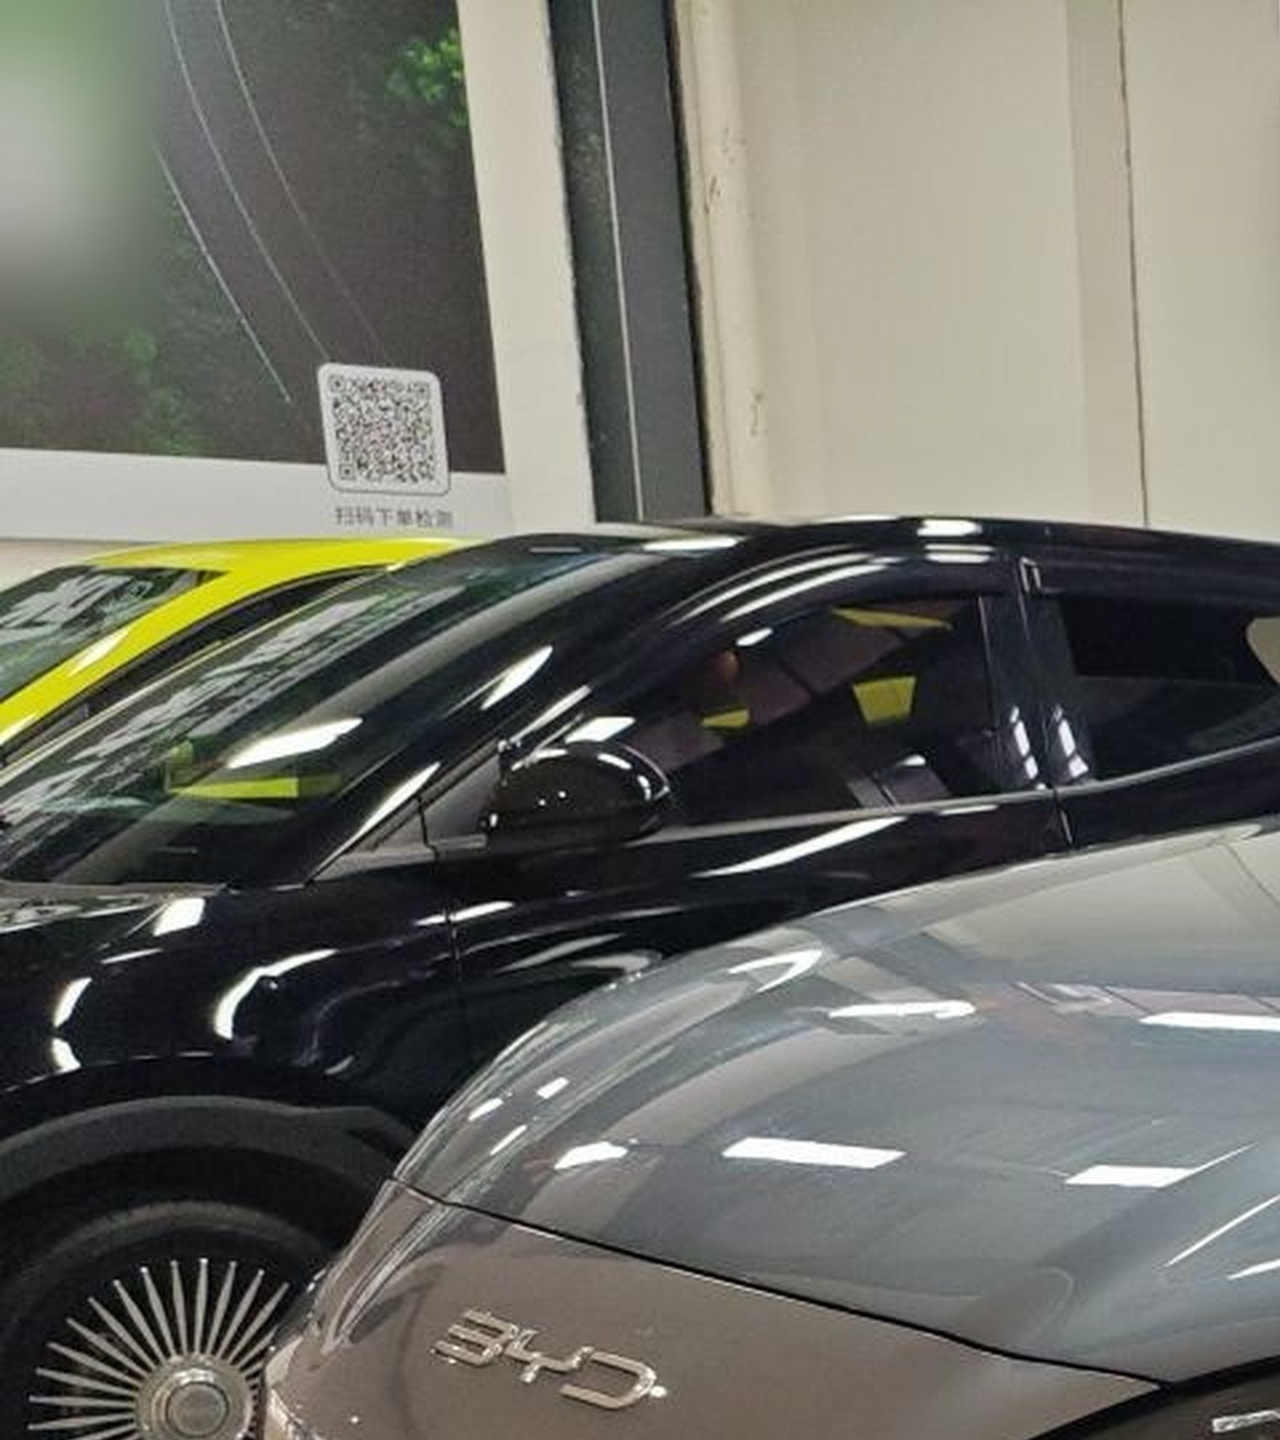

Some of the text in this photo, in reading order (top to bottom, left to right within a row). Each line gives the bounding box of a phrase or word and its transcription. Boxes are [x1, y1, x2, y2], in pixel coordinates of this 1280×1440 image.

[335, 505, 453, 528] 扫码下单检测
[430, 1309, 658, 1411] BYD
